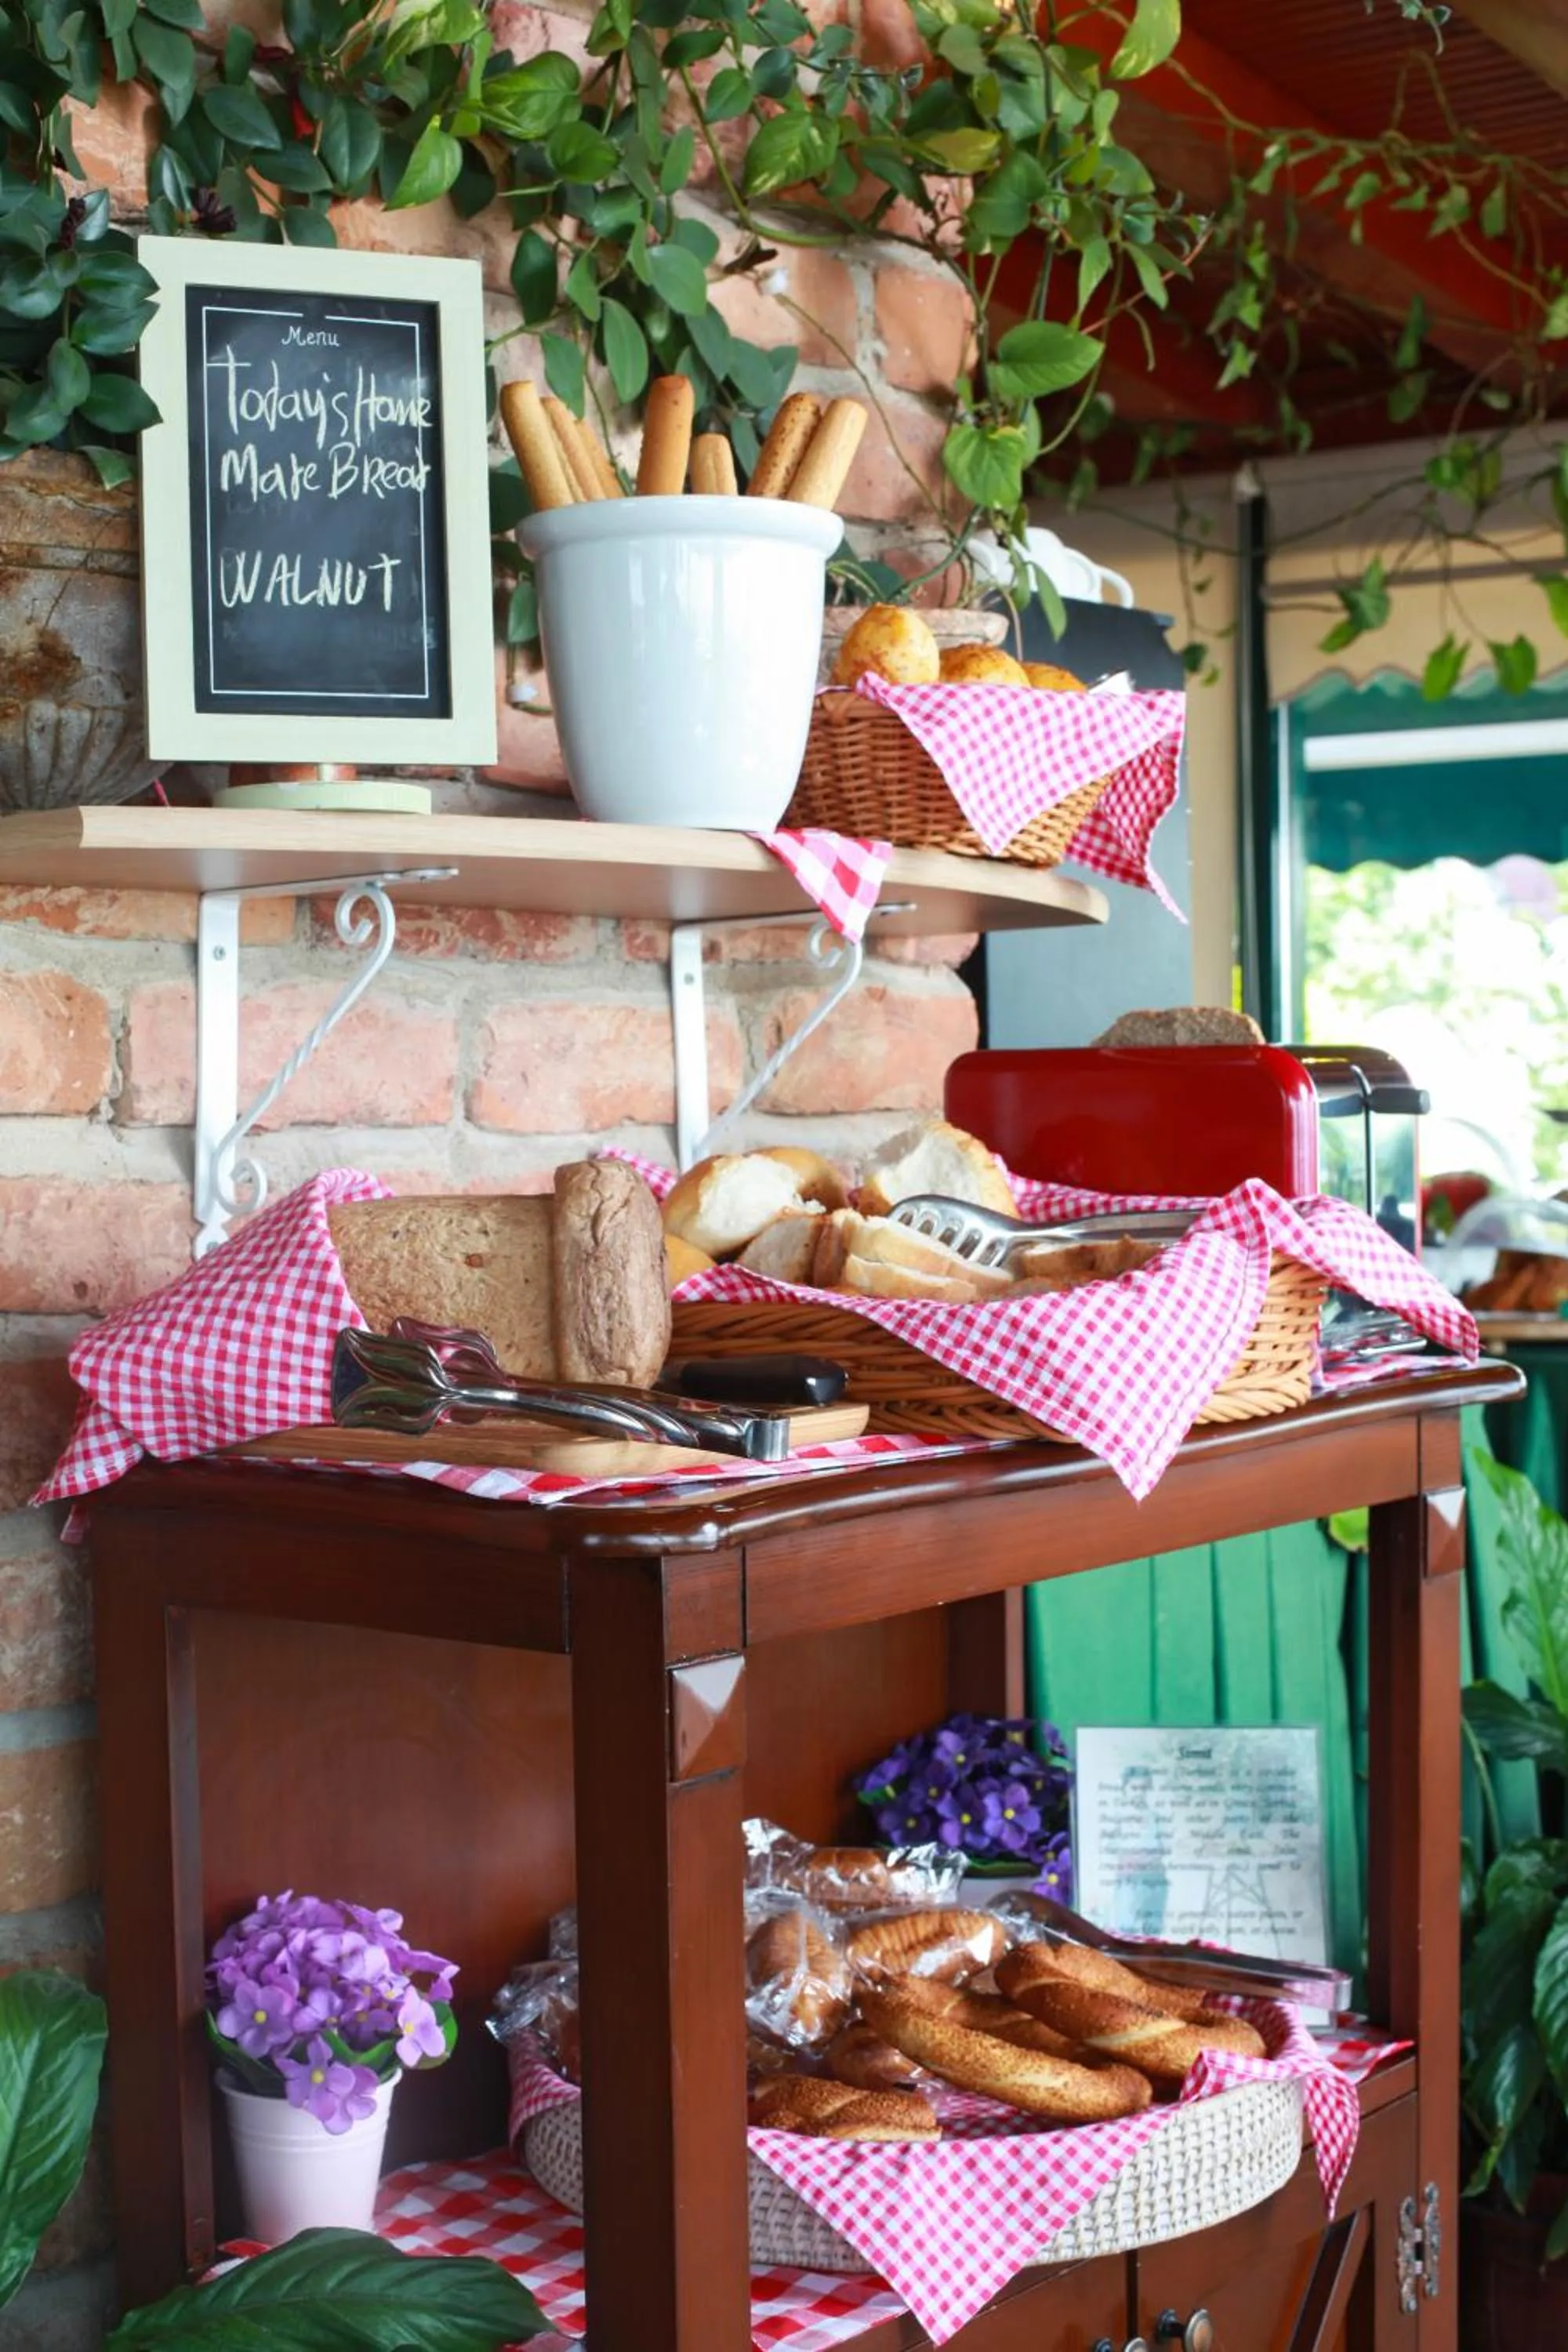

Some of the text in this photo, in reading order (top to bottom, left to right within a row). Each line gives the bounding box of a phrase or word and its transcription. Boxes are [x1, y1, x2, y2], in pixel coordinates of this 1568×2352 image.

[281, 325, 340, 347] Menu
[354, 365, 433, 448] Home
[220, 550, 401, 612] WALNUT
